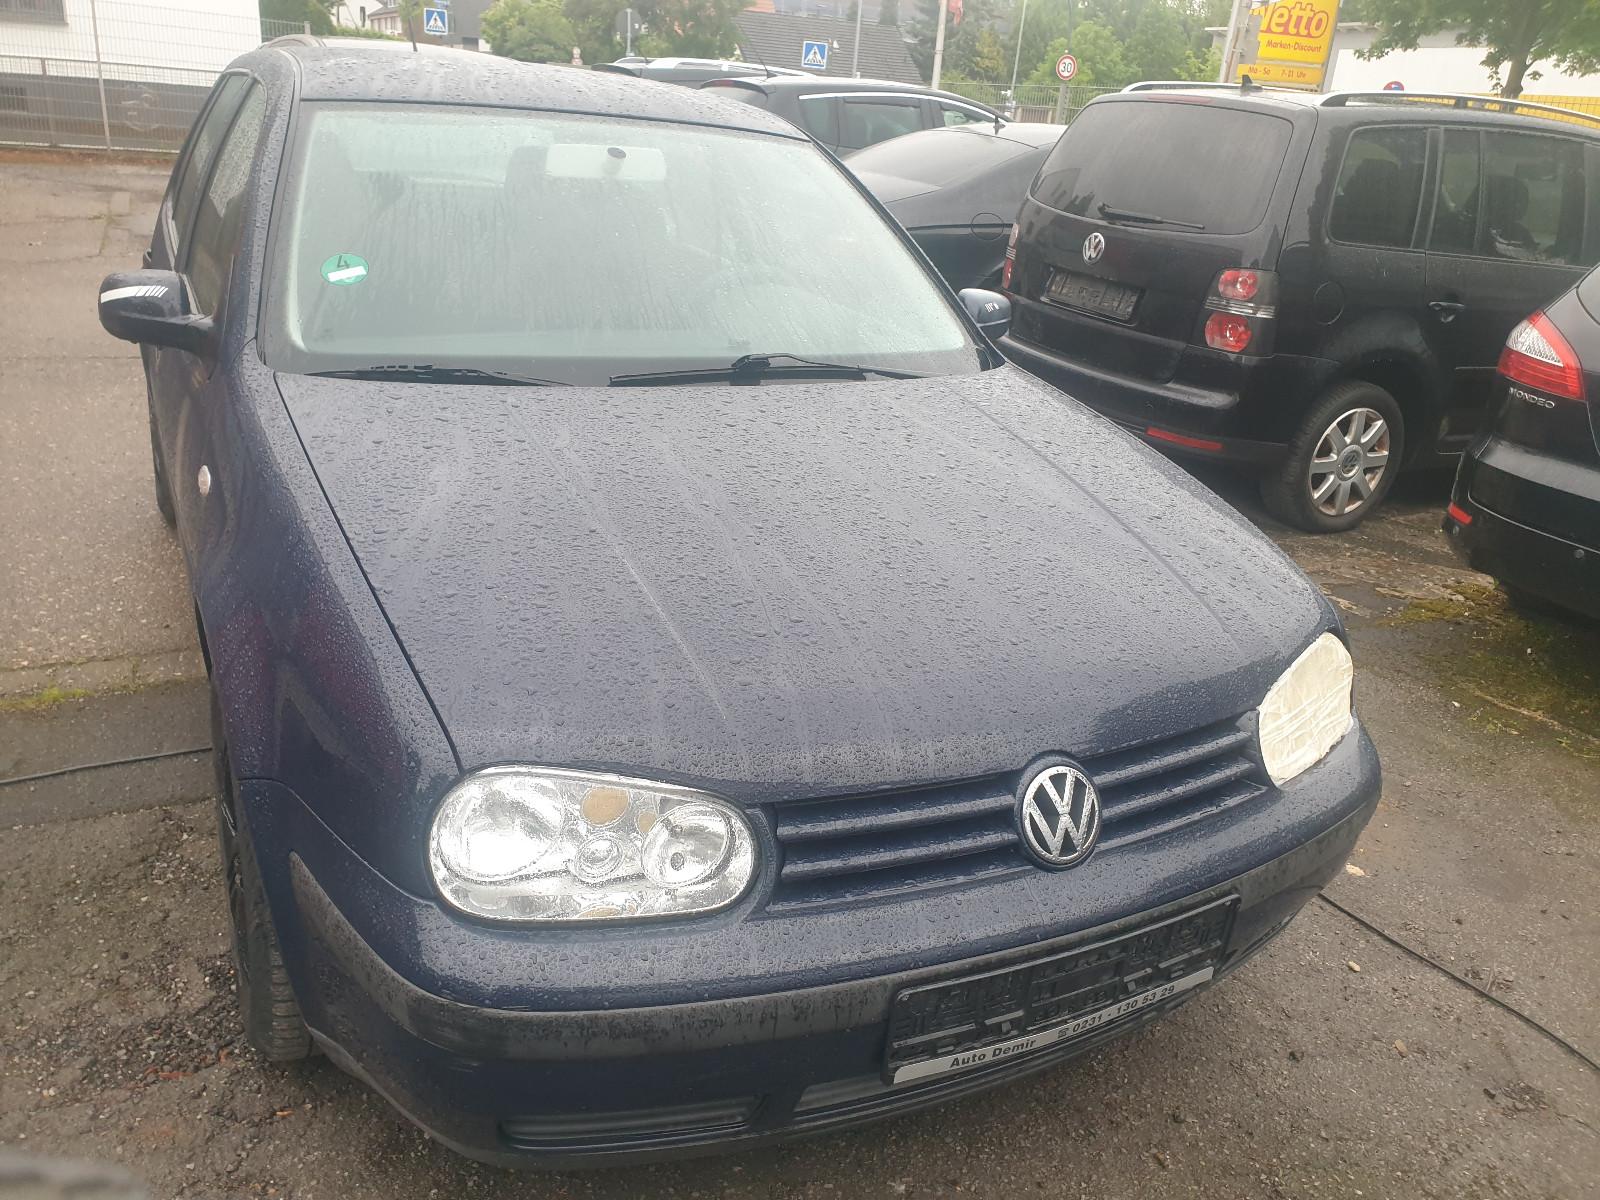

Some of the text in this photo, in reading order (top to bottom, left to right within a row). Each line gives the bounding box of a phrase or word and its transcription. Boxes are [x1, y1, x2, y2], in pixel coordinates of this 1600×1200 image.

[1265, 39, 1322, 53] Marken-Discount
[1061, 62, 1073, 73] 30
[1509, 386, 1555, 409] MONDEO
[950, 1053, 986, 1068] Auto
[991, 1039, 1037, 1058] Demir
[1072, 1013, 1103, 1033] 0231
[1116, 999, 1138, 1015] 130
[1141, 992, 1157, 1005] 53
[1160, 984, 1175, 998] 29
